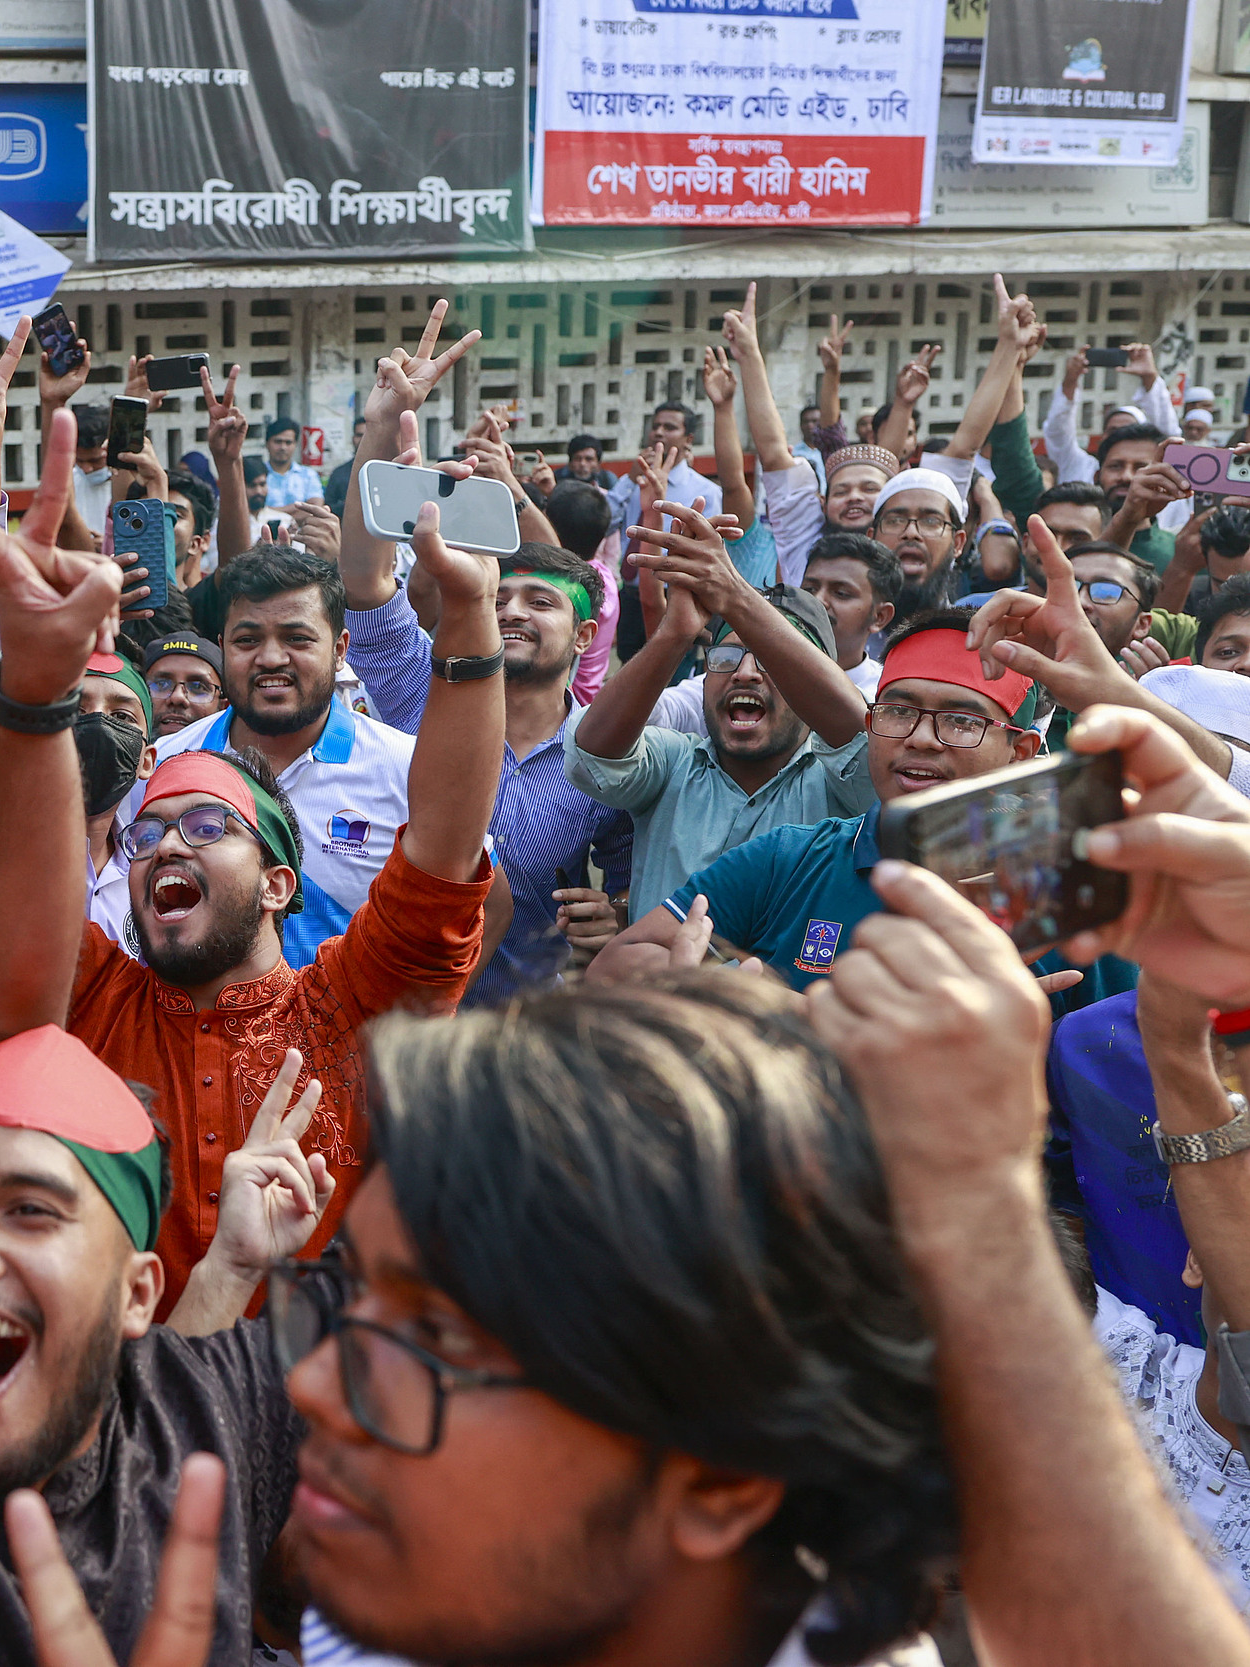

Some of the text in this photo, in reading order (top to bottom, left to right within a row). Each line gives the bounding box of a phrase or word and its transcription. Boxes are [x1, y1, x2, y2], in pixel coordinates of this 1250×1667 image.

[458, 67, 480, 89] এই
[684, 94, 735, 118] কমল
[742, 87, 791, 119] মেডি
[867, 89, 911, 121] ঢাবি
[1083, 90, 1137, 109] CULTURAL
[1137, 92, 1166, 110] CLUB
[587, 155, 871, 197] শেখ তানভীর বারী হামিম
[108, 177, 321, 231] সন্ত্রাসবিরোধী
[162, 641, 199, 652] SMILE
[321, 843, 370, 856] INTERNATIONAL
[330, 840, 362, 850] BROTHERS
